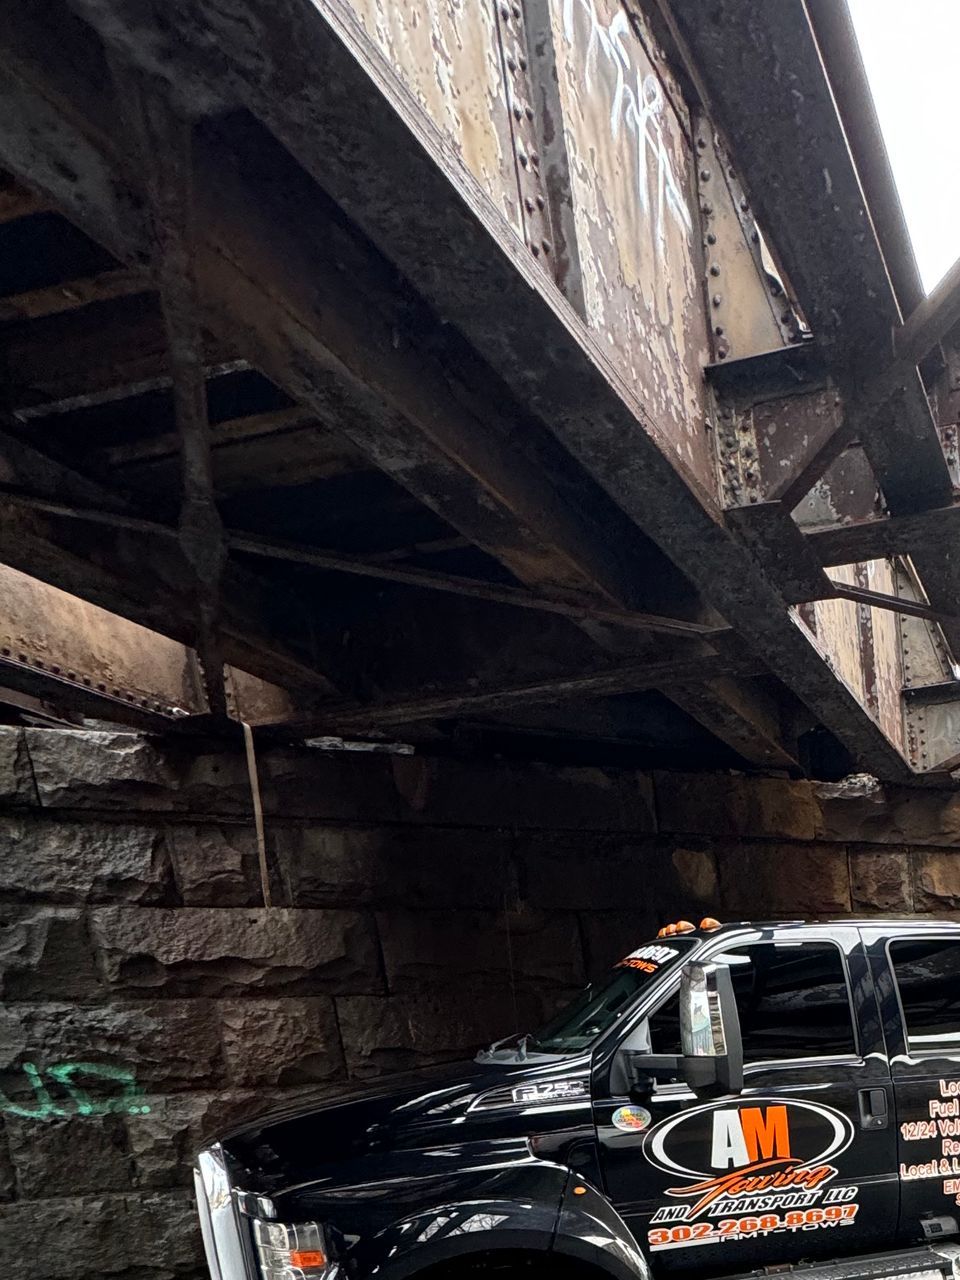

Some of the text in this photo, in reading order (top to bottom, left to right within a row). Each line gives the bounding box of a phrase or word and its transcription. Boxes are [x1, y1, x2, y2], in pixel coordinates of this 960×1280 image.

[929, 1099, 960, 1118] Fuel
[711, 1105, 791, 1168] AM
[900, 1121, 938, 1140] 12/24
[900, 1160, 938, 1181] Local
[938, 1158, 951, 1176] &
[664, 1158, 839, 1220] Towing
[649, 1187, 859, 1224] AND TRANSPORT LLC
